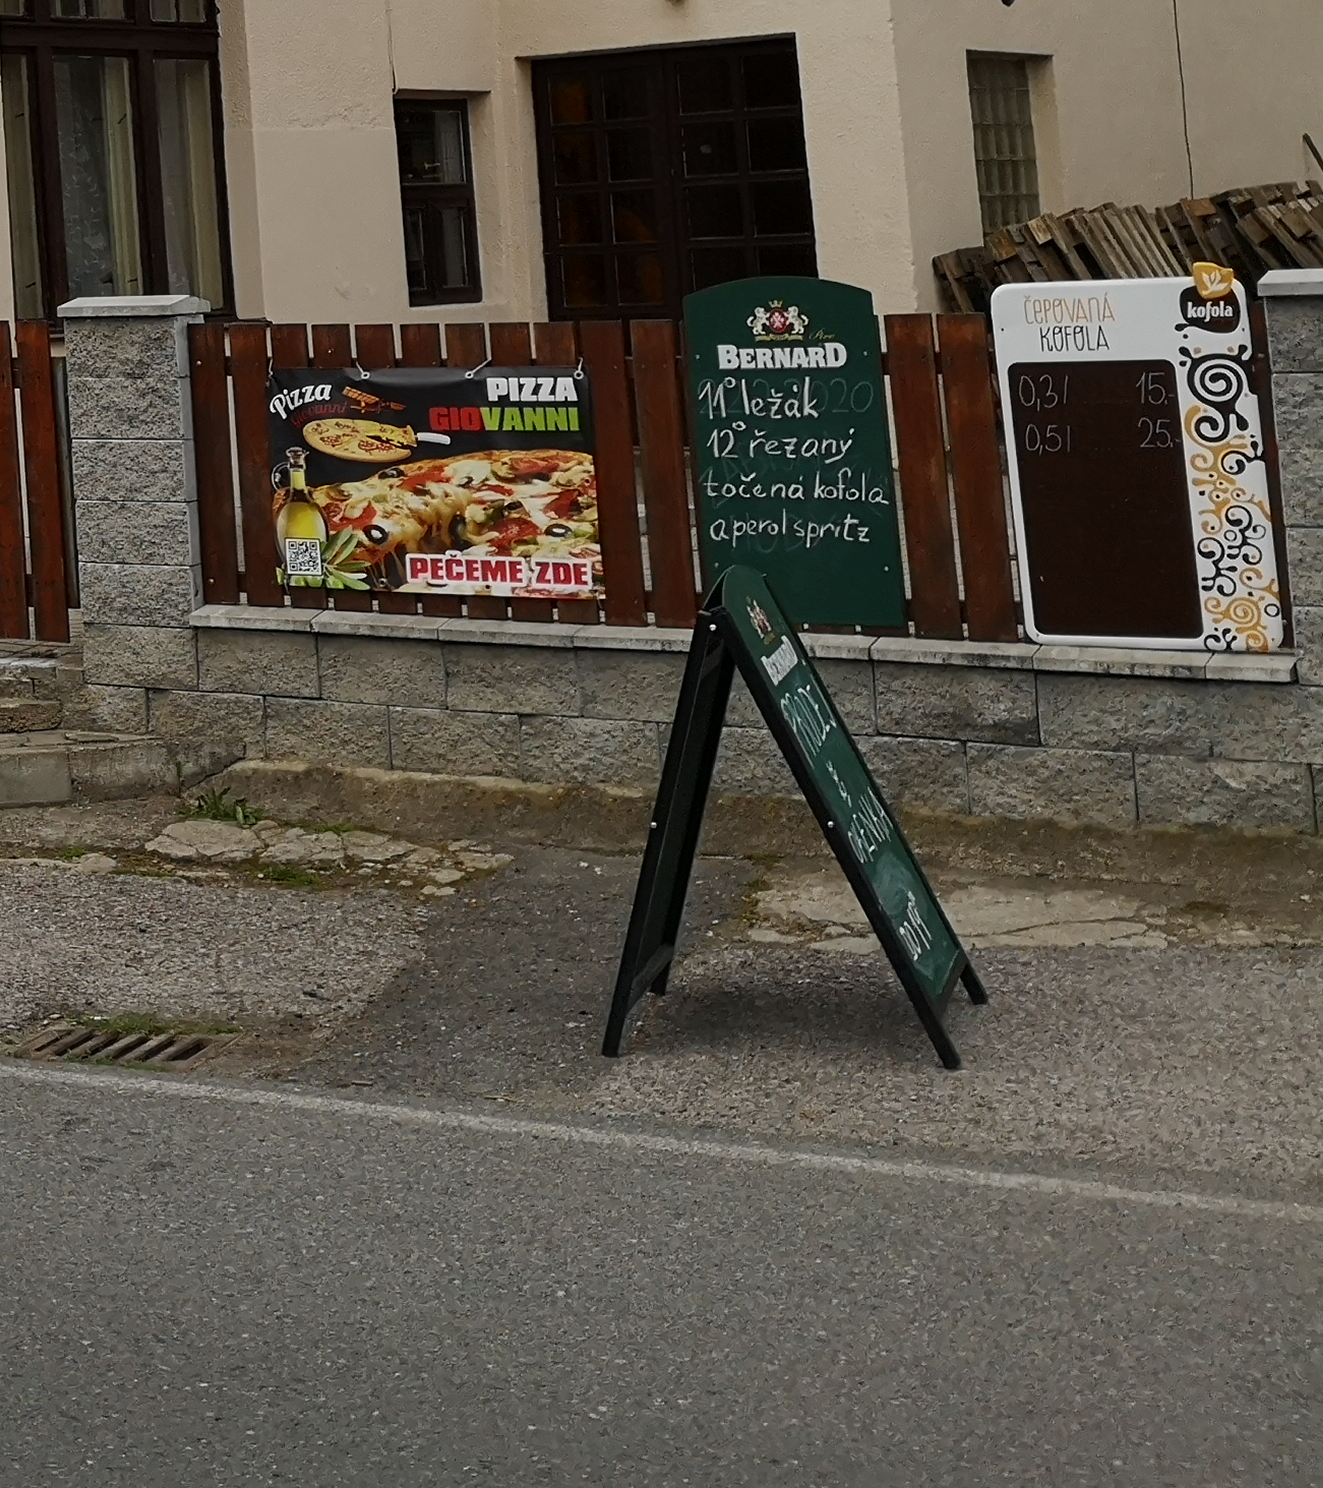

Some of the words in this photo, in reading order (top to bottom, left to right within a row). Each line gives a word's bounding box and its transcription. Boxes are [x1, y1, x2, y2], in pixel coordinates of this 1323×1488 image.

[1187, 301, 1233, 323] kofola
[1039, 325, 1110, 352] KOFOLA
[717, 342, 847, 370] BERNARD
[269, 383, 333, 420] Pizza
[486, 377, 578, 402] PIZZA
[741, 376, 820, 419] ležák
[429, 406, 580, 432] GIOVANNI
[702, 471, 805, 500] točená
[813, 467, 890, 505] kofola
[794, 513, 871, 548] spritz
[409, 552, 524, 584] PEČEME
[535, 561, 589, 586] ZDE
